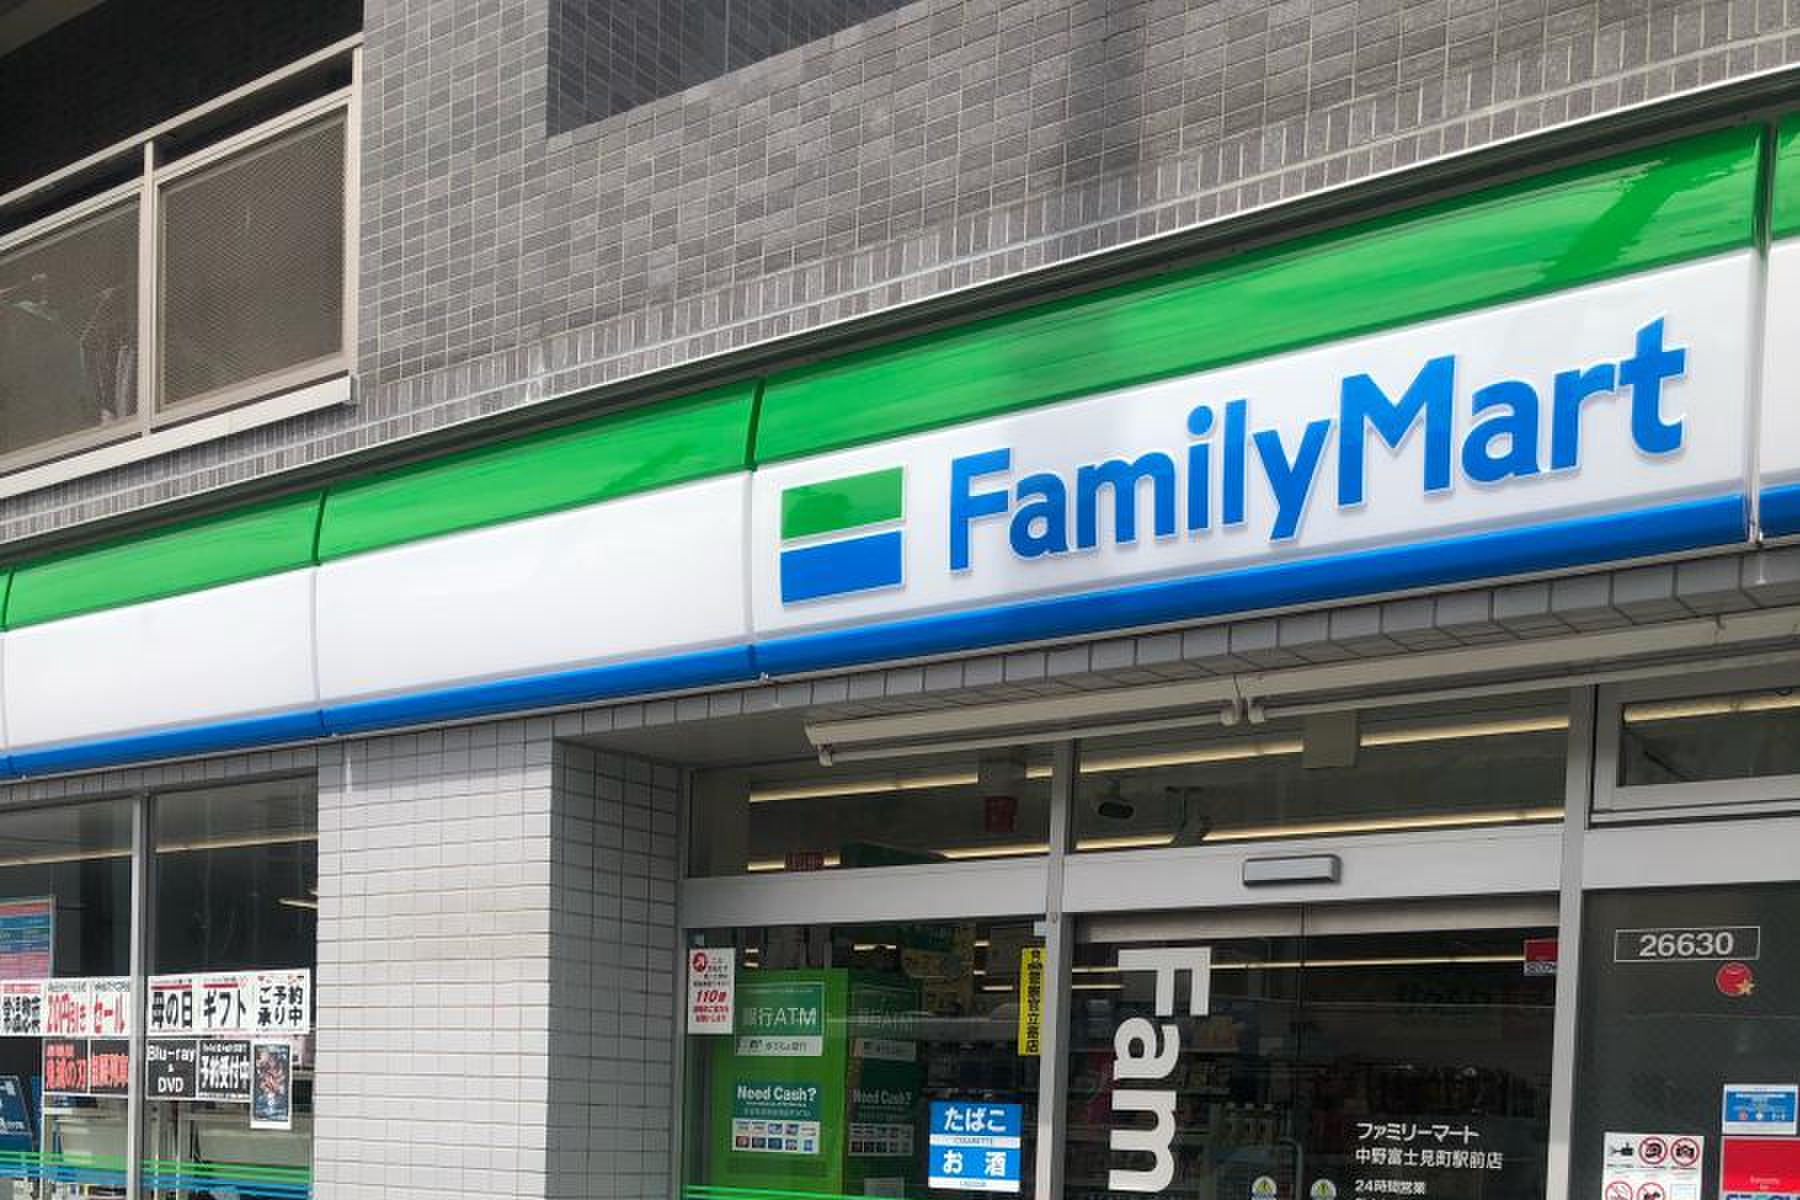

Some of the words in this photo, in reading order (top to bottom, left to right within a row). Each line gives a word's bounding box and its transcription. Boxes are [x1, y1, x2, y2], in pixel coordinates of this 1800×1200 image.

[948, 315, 1688, 572] FamilyMart
[1639, 932, 1735, 957] 26630
[258, 985, 304, 1005] ご予約
[151, 991, 193, 1029] 母の日
[203, 988, 247, 1029] ギフト
[257, 1007, 304, 1028] 承り中
[147, 1045, 195, 1062] Blu-ray
[157, 1077, 185, 1093] DVD
[736, 1085, 771, 1102] Need
[772, 1086, 817, 1103] Cash?
[943, 1106, 1007, 1132] たばこ
[1355, 1122, 1480, 1145] ファミリーマート
[943, 1149, 1007, 1177] お酒
[1355, 1147, 1503, 1170] 中野富士見町駅前店
[1354, 1179, 1427, 1195] 24時間営業
